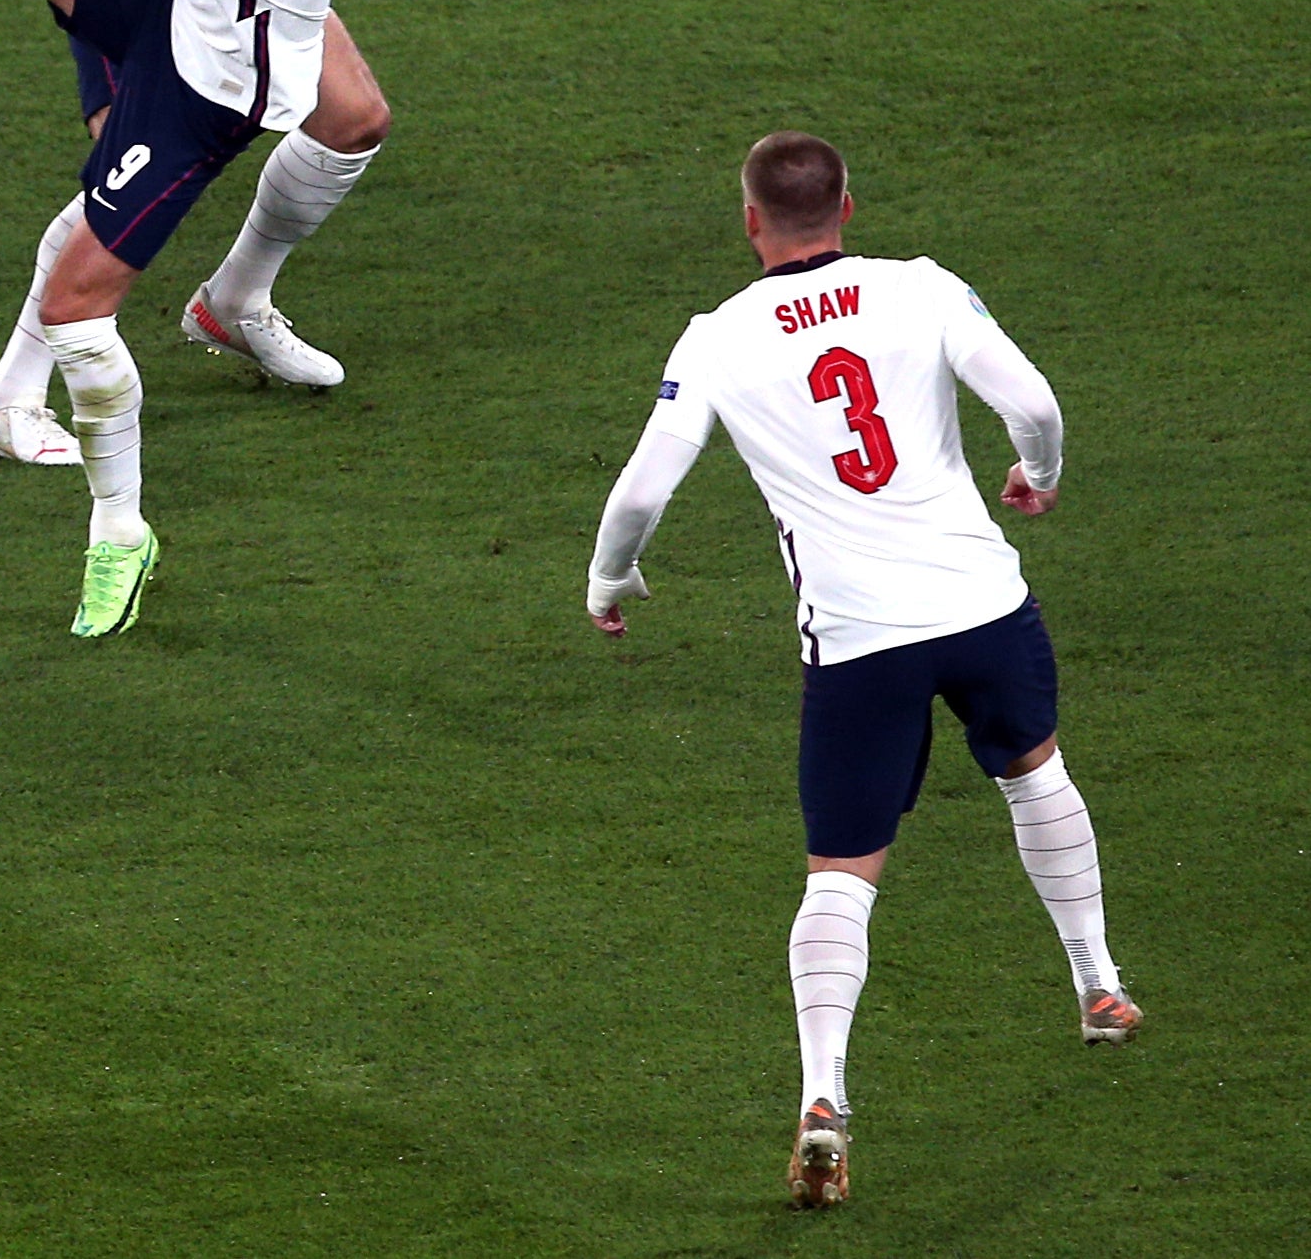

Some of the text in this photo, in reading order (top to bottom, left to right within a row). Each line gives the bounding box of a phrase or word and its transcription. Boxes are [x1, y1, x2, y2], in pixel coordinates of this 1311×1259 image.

[105, 143, 152, 191] 9
[774, 285, 861, 334] SHAW
[807, 346, 900, 495] 3
